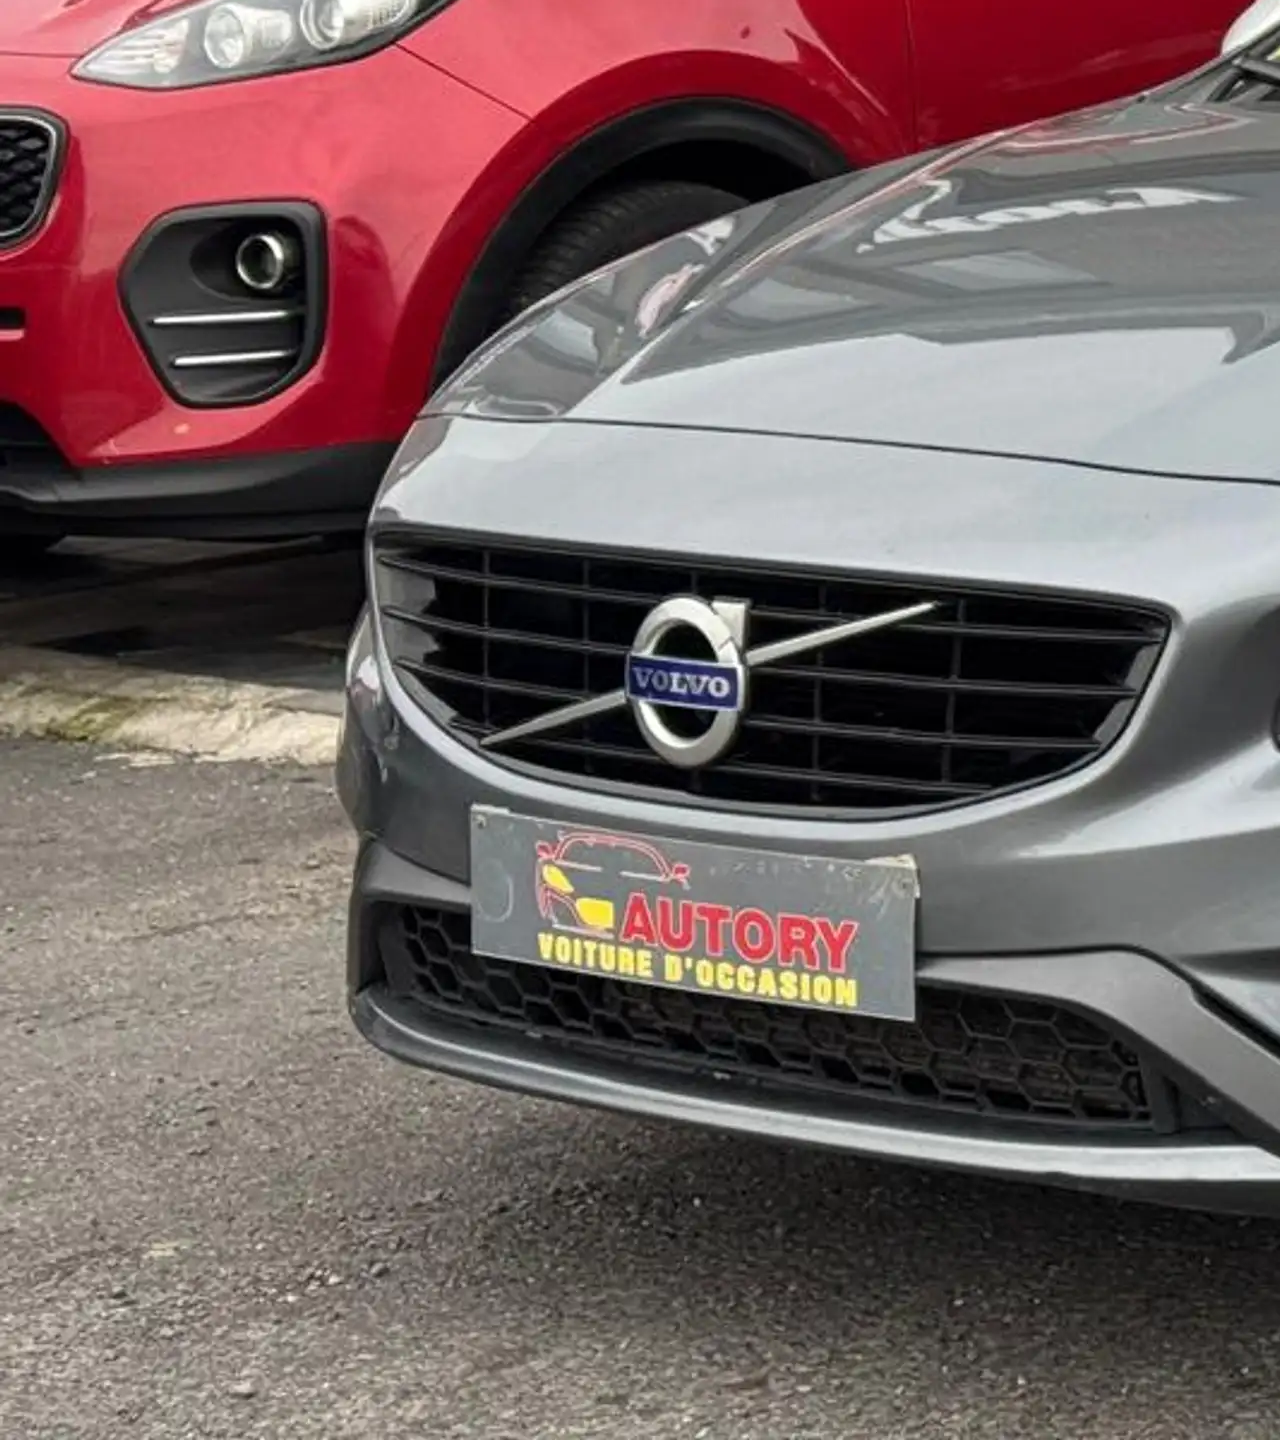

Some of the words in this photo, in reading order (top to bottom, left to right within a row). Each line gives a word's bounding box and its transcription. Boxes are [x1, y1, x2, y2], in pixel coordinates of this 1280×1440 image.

[632, 667, 731, 698] VOLVO
[537, 932, 653, 976] VOITURE
[664, 954, 858, 1007] D'OCCASION
[621, 891, 860, 974] AUTORY
